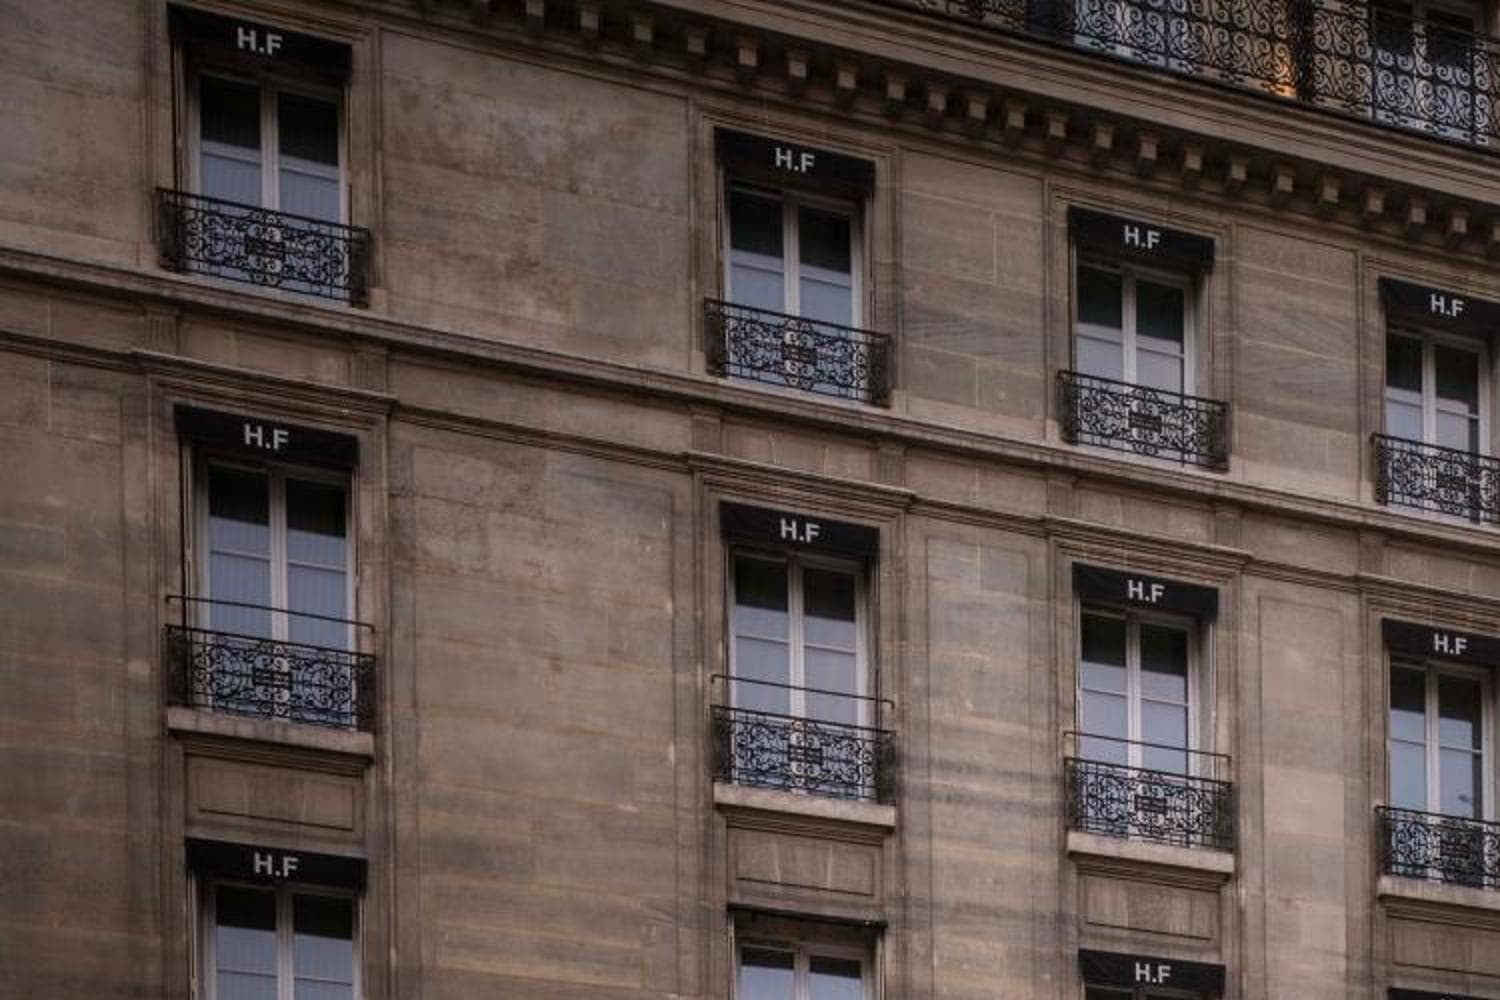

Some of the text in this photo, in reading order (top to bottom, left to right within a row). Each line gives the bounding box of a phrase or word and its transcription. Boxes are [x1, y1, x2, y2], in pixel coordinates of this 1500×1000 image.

[238, 27, 282, 54] H.F
[776, 148, 814, 172] H.F
[1125, 225, 1160, 248] H.F
[1431, 294, 1463, 316] H.F
[245, 424, 288, 449] H.F
[781, 519, 819, 542] H.F
[1128, 580, 1164, 602] H.F
[1434, 634, 1466, 654] H.F
[255, 853, 298, 877] H.F
[1136, 963, 1170, 983] H.F
